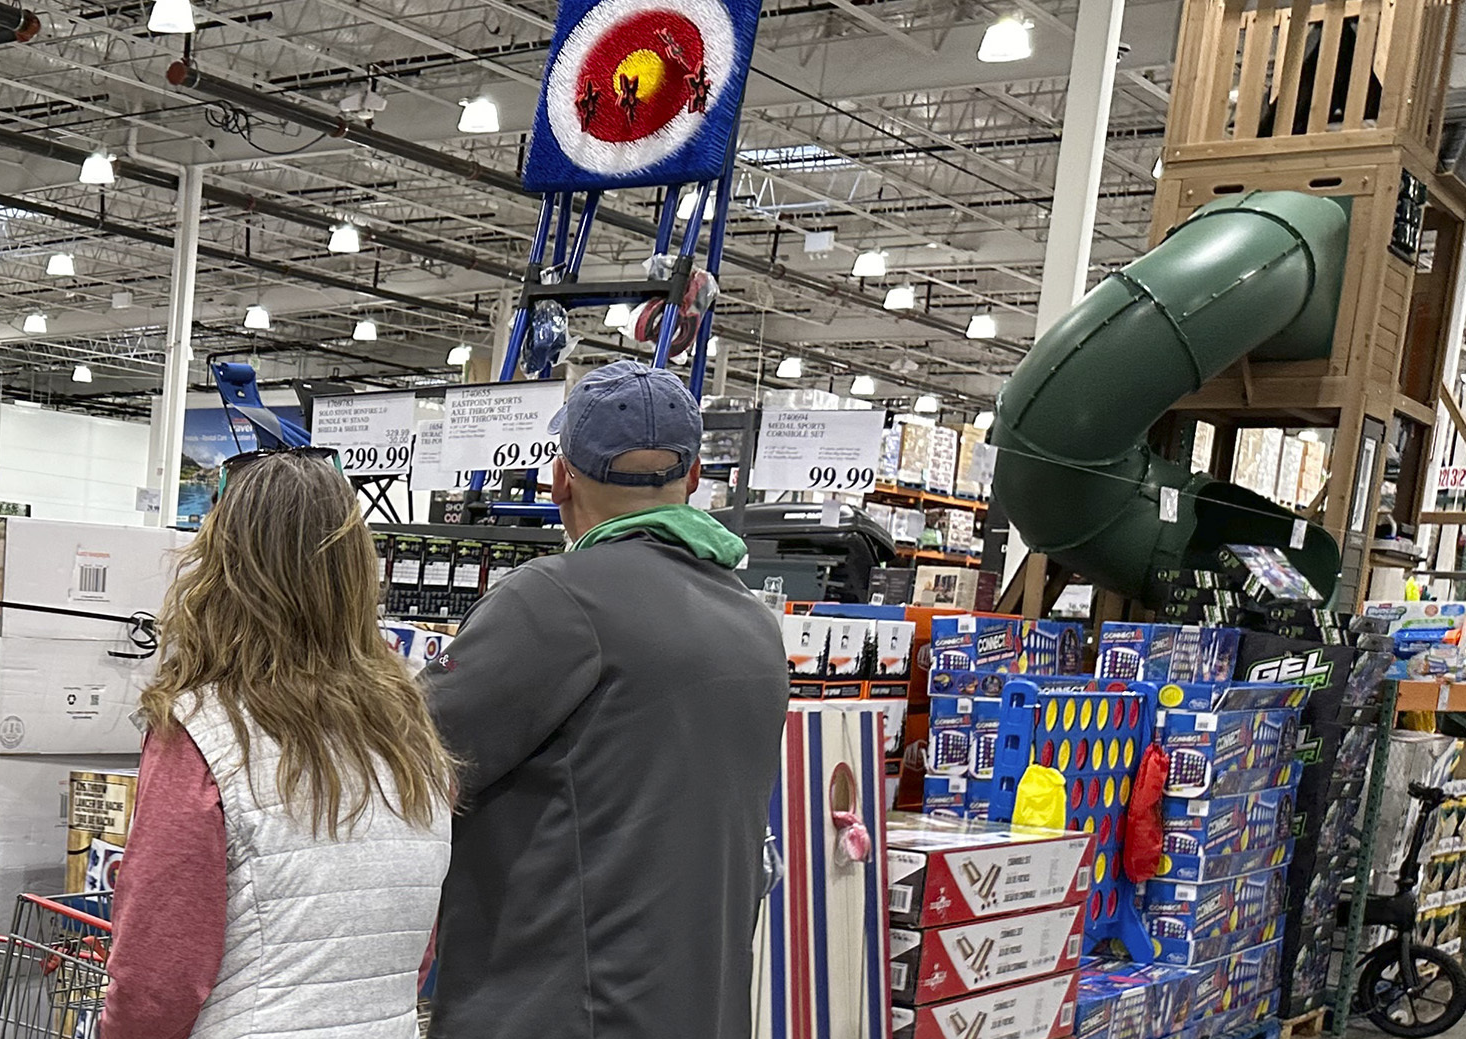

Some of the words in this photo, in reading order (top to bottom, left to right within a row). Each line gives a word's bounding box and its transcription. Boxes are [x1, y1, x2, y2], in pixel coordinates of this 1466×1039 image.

[452, 398, 492, 408] EASTPOINT
[494, 396, 522, 405] SPORTS
[334, 408, 352, 416] STOVE
[450, 408, 468, 416] AXE
[469, 406, 495, 415] THROW
[350, 416, 370, 424] STAND
[450, 416, 470, 424] WITH
[471, 414, 512, 422] THROWING
[514, 412, 538, 420] STARS
[344, 424, 369, 432] SHELTER
[768, 422, 794, 430] MEDAL
[796, 422, 826, 430] SPORTS
[422, 430, 443, 438] DURAC
[766, 430, 808, 438] CORNHOLE
[810, 430, 825, 438] SET
[344, 446, 410, 470] 299.99
[492, 440, 558, 468] 69.99
[455, 470, 503, 488] 1999
[807, 466, 874, 490] 99.99
[934, 637, 964, 646] CONNECT
[1103, 632, 1136, 641] CONNECT
[978, 633, 1006, 654] CONNECT
[1248, 652, 1330, 682] GEL
[1168, 734, 1202, 744] CONNECT
[1216, 729, 1242, 752] CONNECT
[1148, 904, 1182, 912] CONNECT
